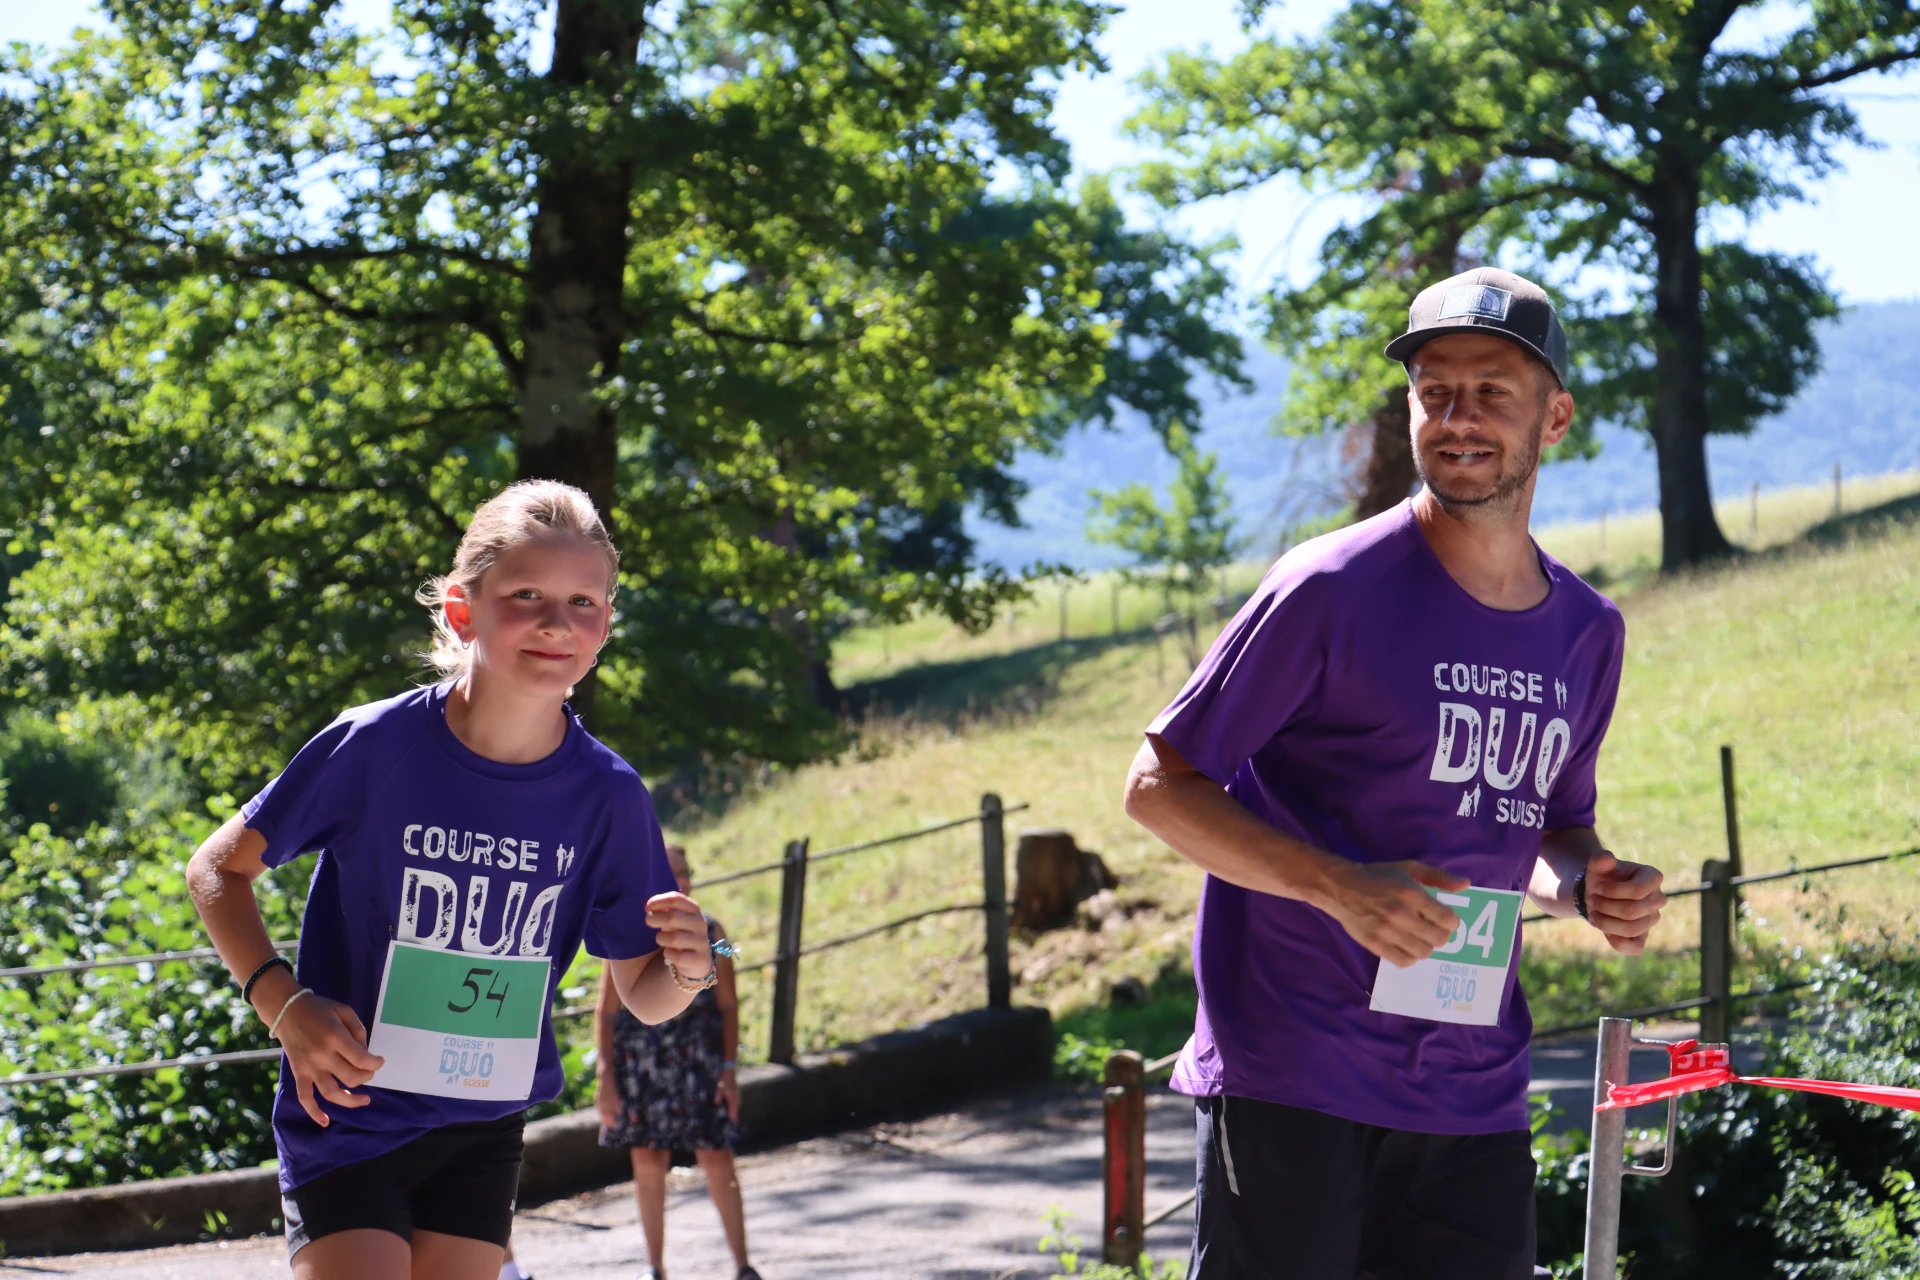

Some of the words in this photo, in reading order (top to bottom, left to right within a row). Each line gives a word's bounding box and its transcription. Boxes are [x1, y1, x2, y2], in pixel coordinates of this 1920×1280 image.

[1434, 662, 1543, 704] COURSE
[1429, 702, 1571, 799] DUO
[1495, 797, 1547, 830] SUISS
[403, 823, 540, 872] COURSE
[397, 866, 565, 957] DUO
[447, 967, 510, 1019] 54
[1436, 975, 1477, 1003] DUO
[443, 1036, 484, 1050] COURSE
[438, 1048, 494, 1078] DUO
[462, 1078, 491, 1088] SUISSE
